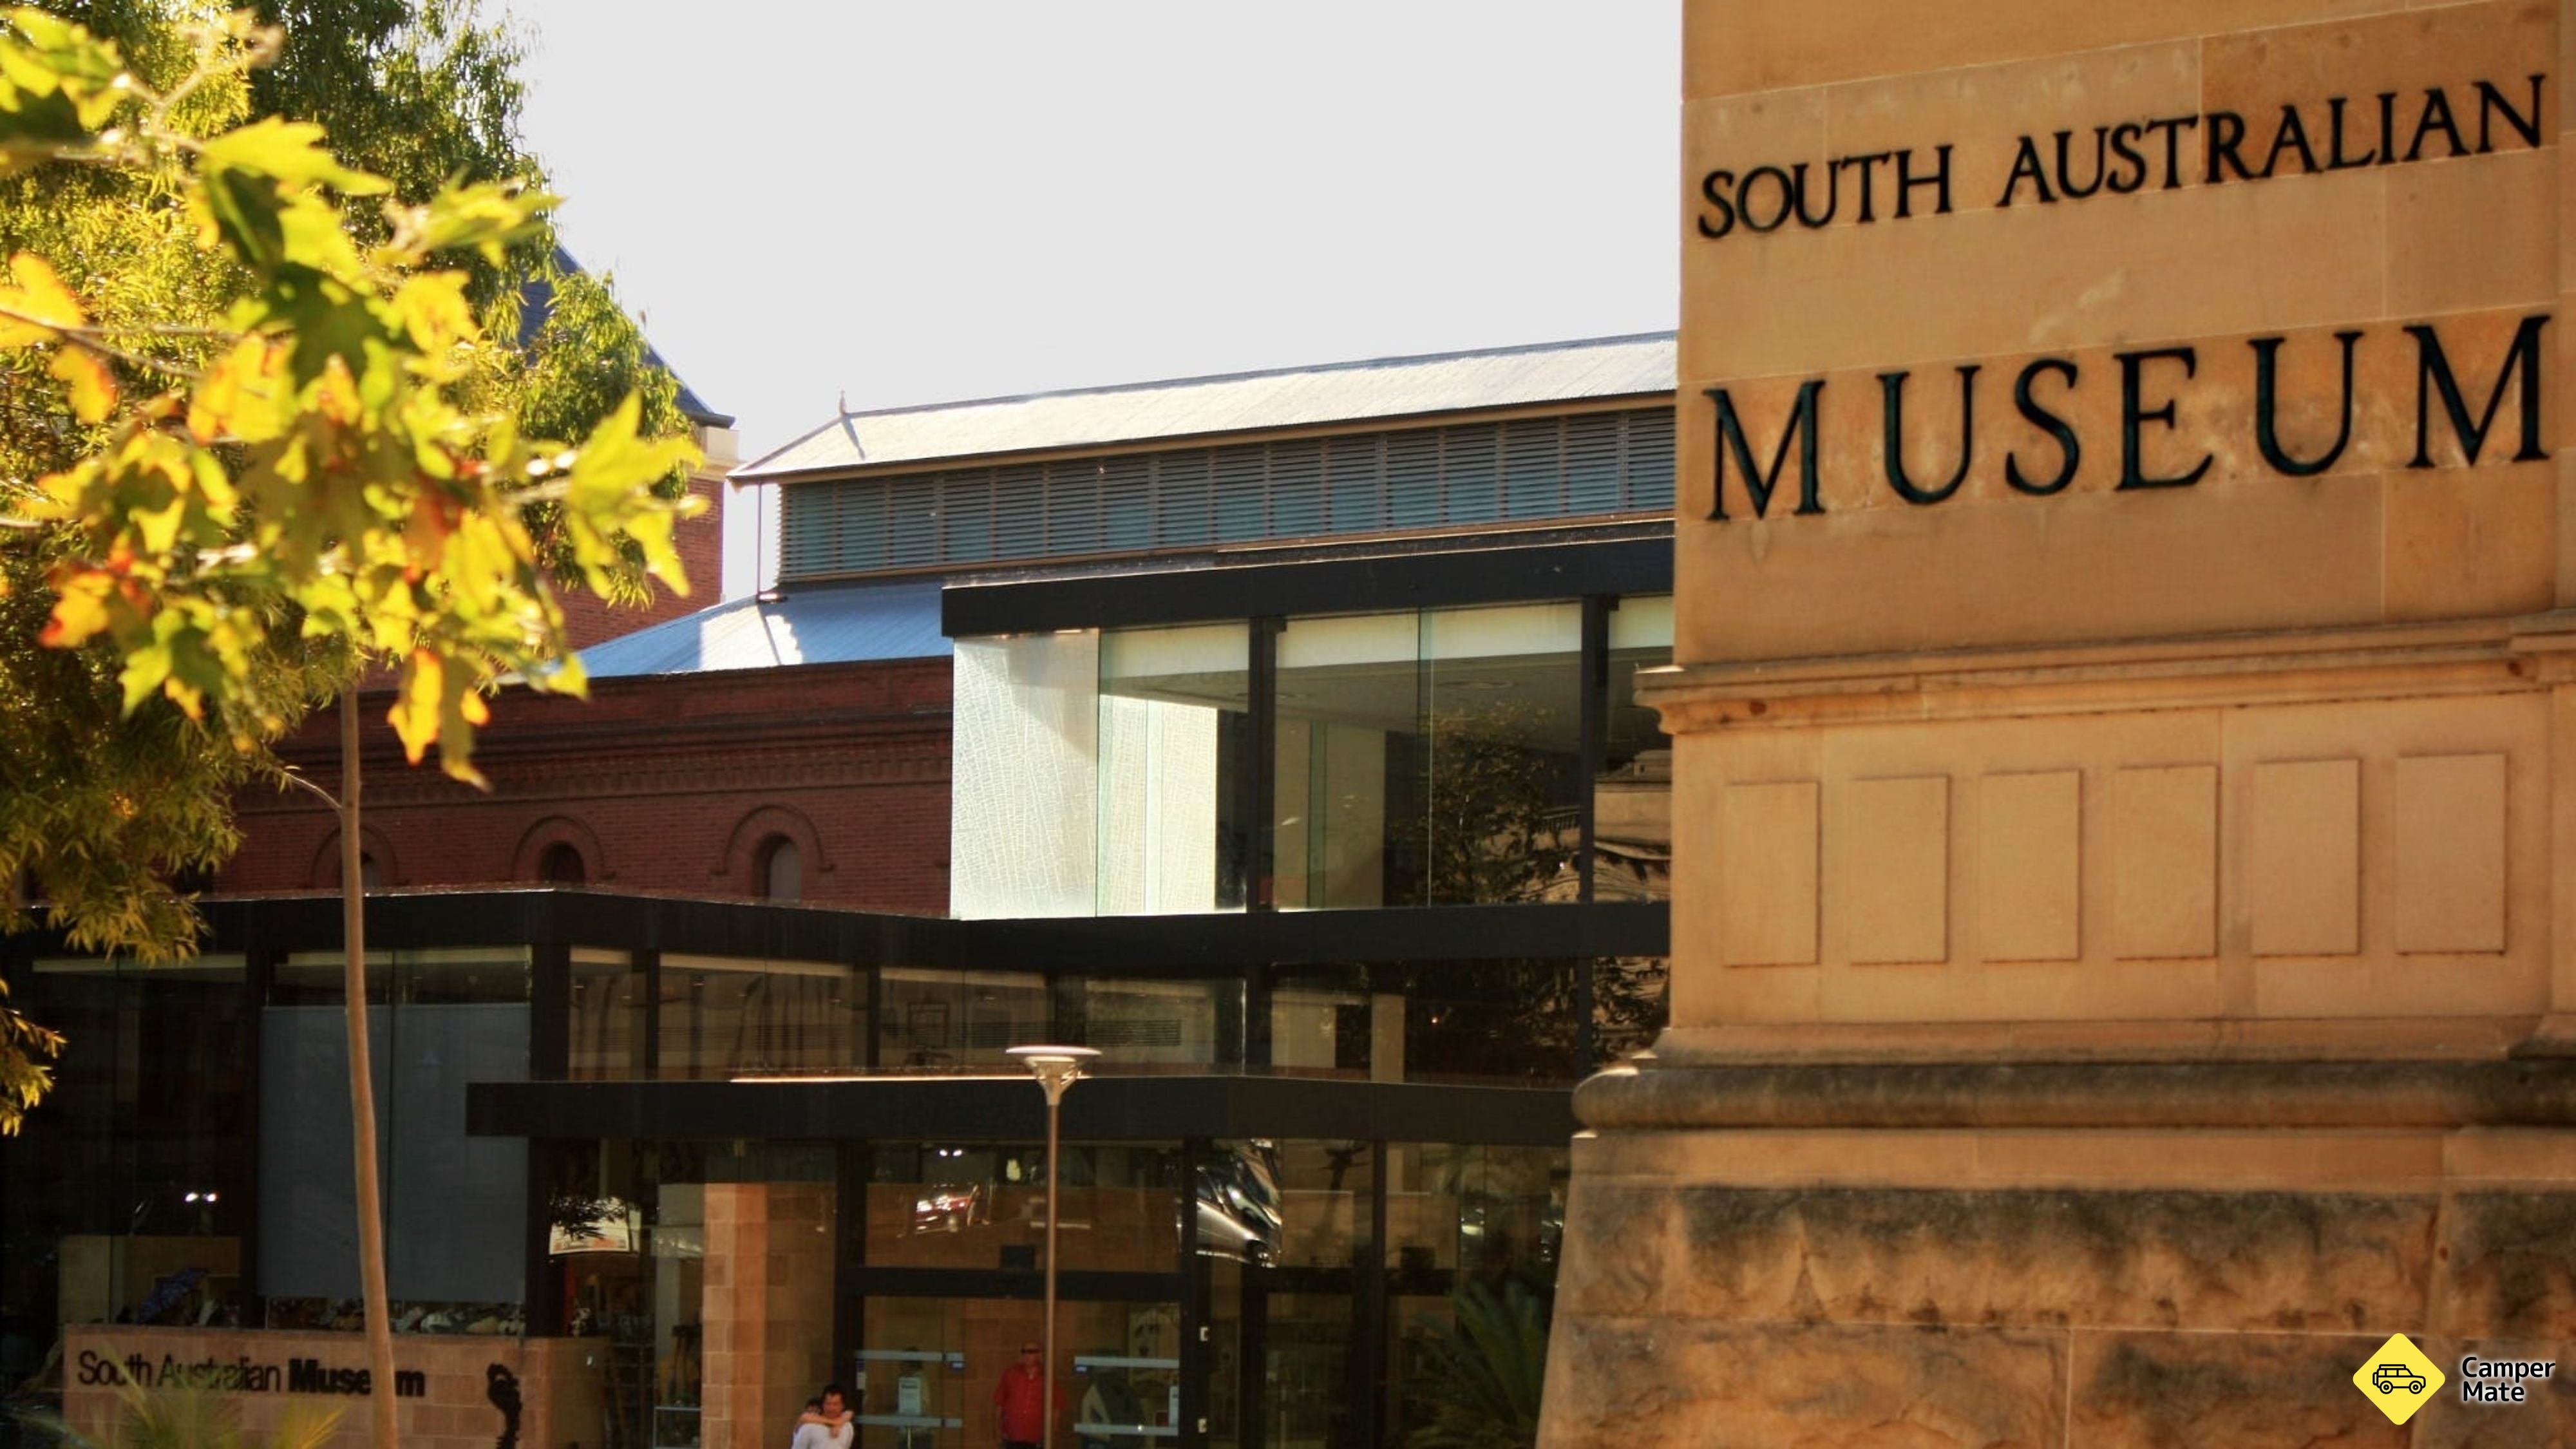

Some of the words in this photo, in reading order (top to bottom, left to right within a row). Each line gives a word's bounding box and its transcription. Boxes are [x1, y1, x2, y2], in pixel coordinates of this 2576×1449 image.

[1697, 143, 1953, 239] SOUTH
[1994, 74, 2548, 208] AUSTRALIAN
[1702, 314, 2552, 522] MUSEUM
[78, 1349, 152, 1387] South
[289, 1358, 425, 1397] Musem
